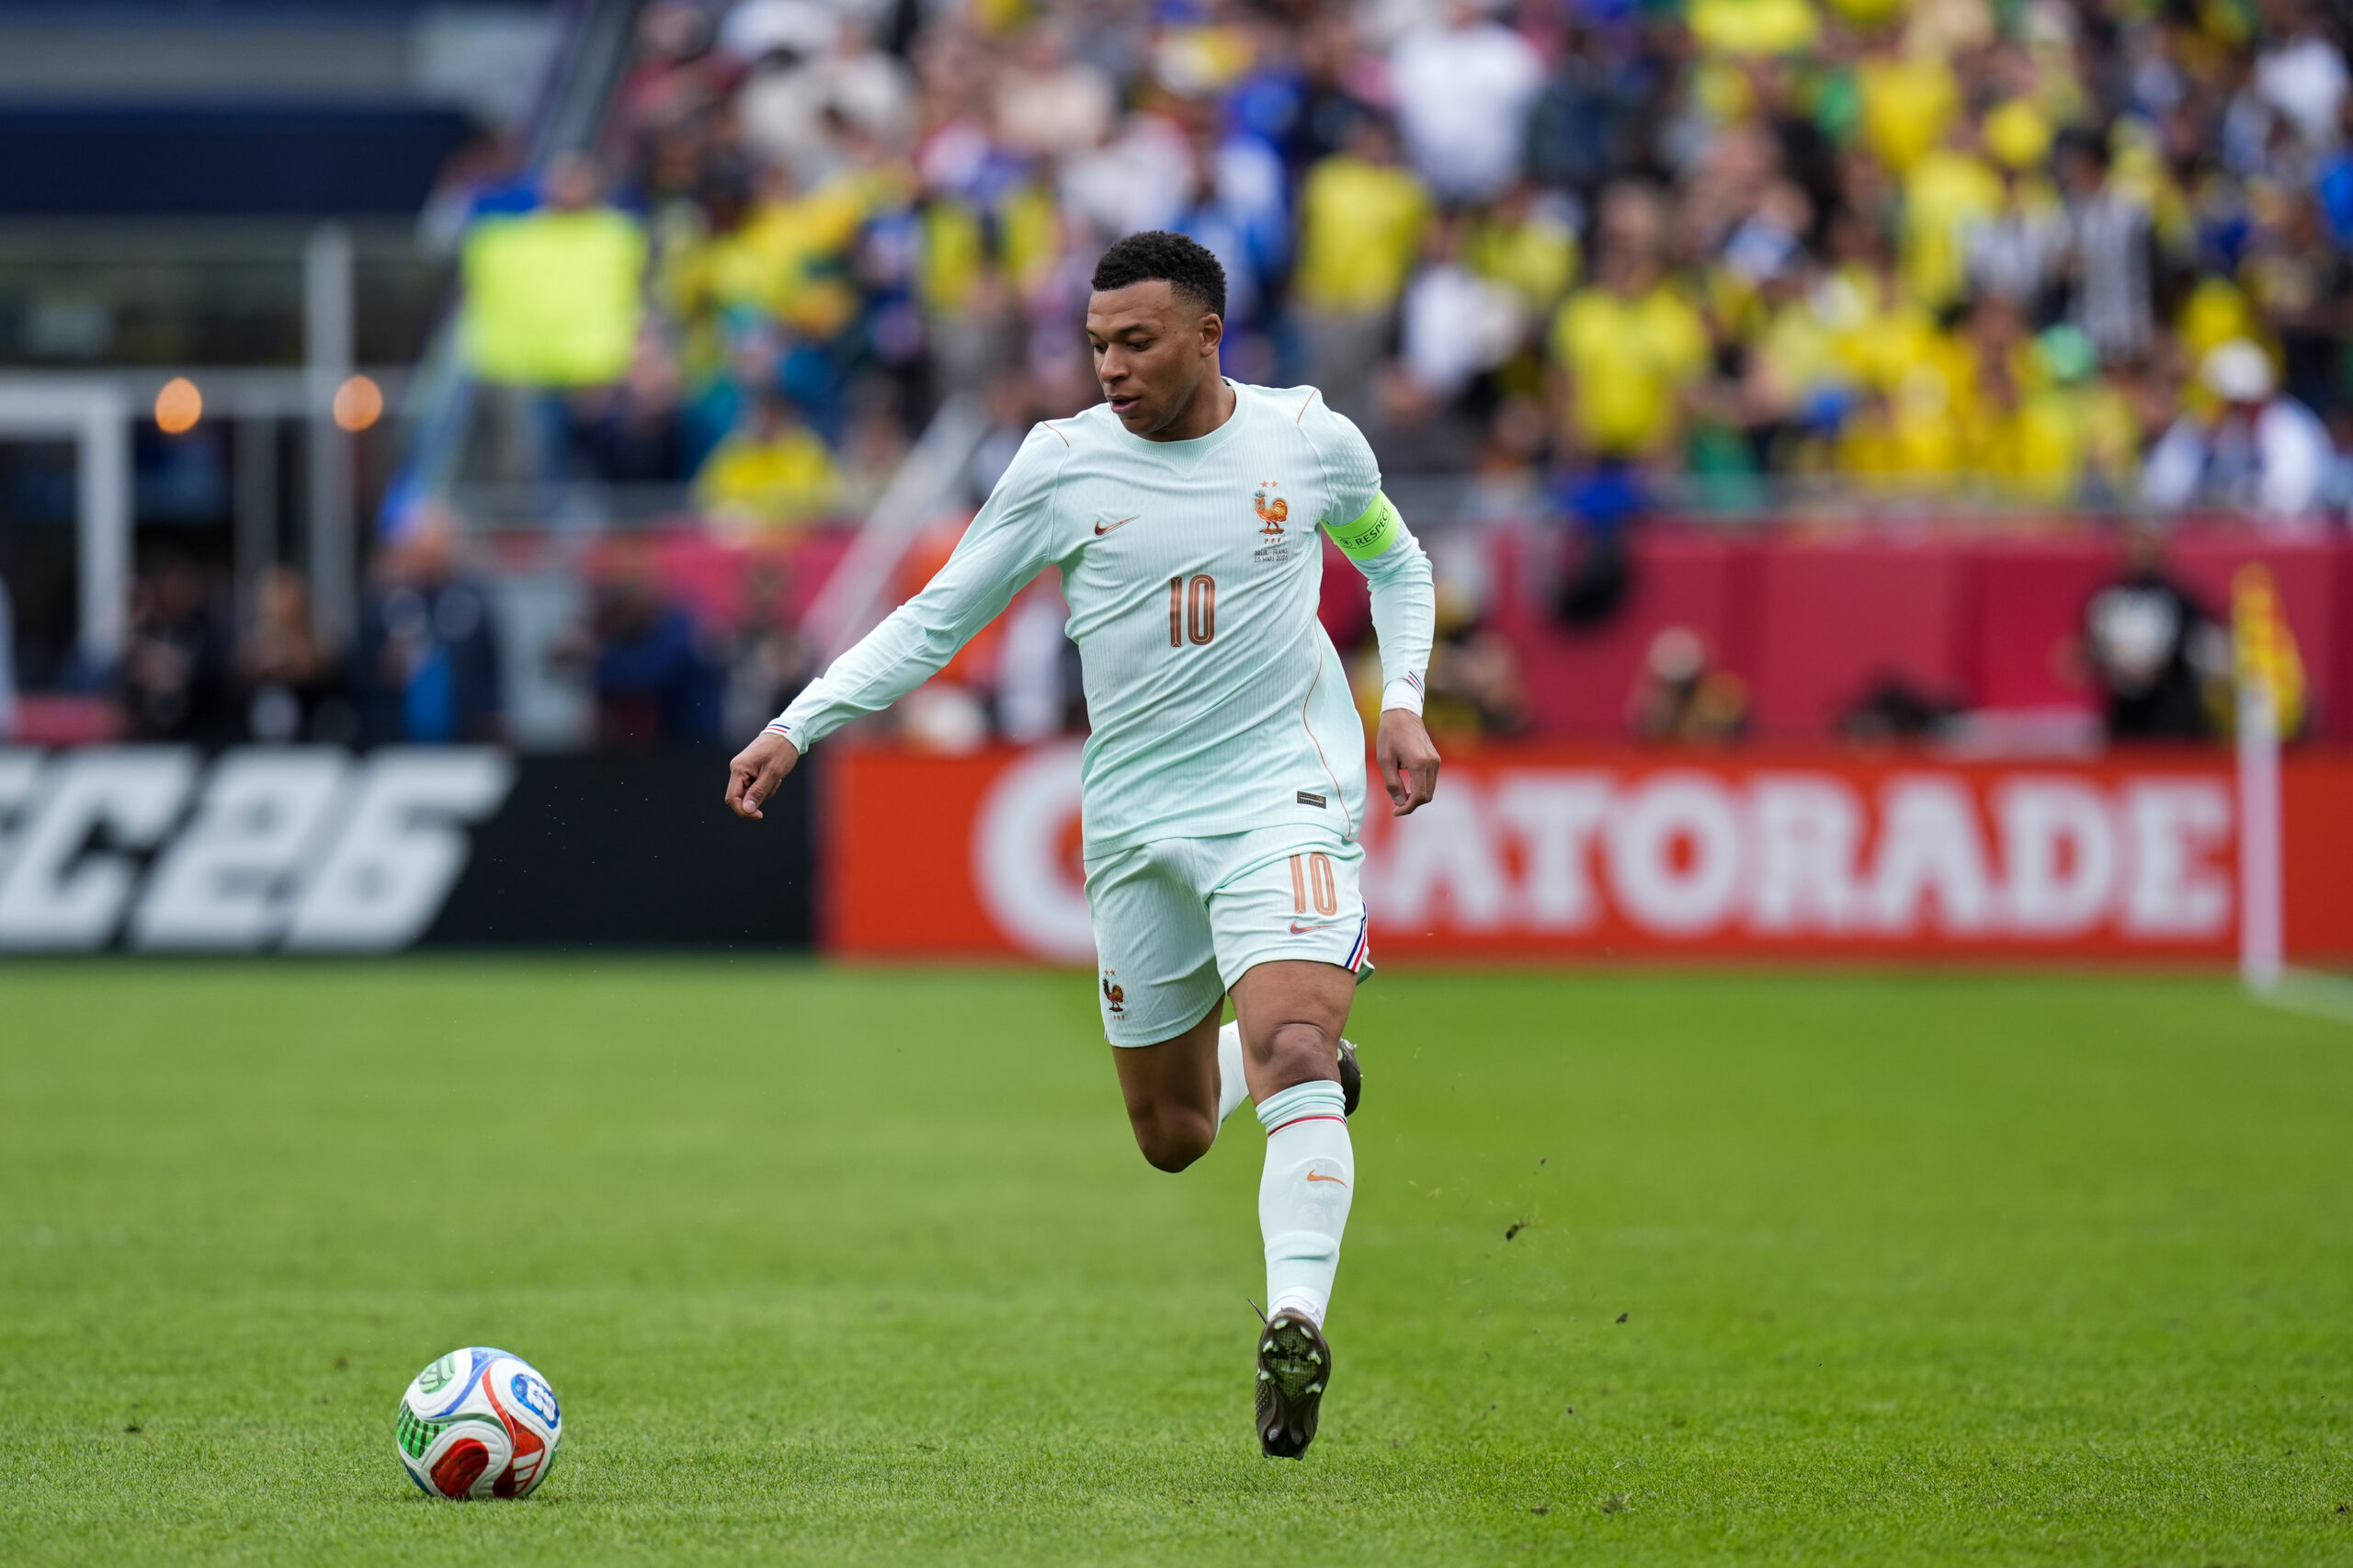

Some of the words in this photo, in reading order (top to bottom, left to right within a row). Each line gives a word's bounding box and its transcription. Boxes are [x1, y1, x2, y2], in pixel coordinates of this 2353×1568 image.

[1355, 505, 1389, 545] RESPECT
[1170, 574, 1216, 648] 10
[1290, 851, 1338, 916] 10
[1362, 770, 2233, 939] ATORADE
